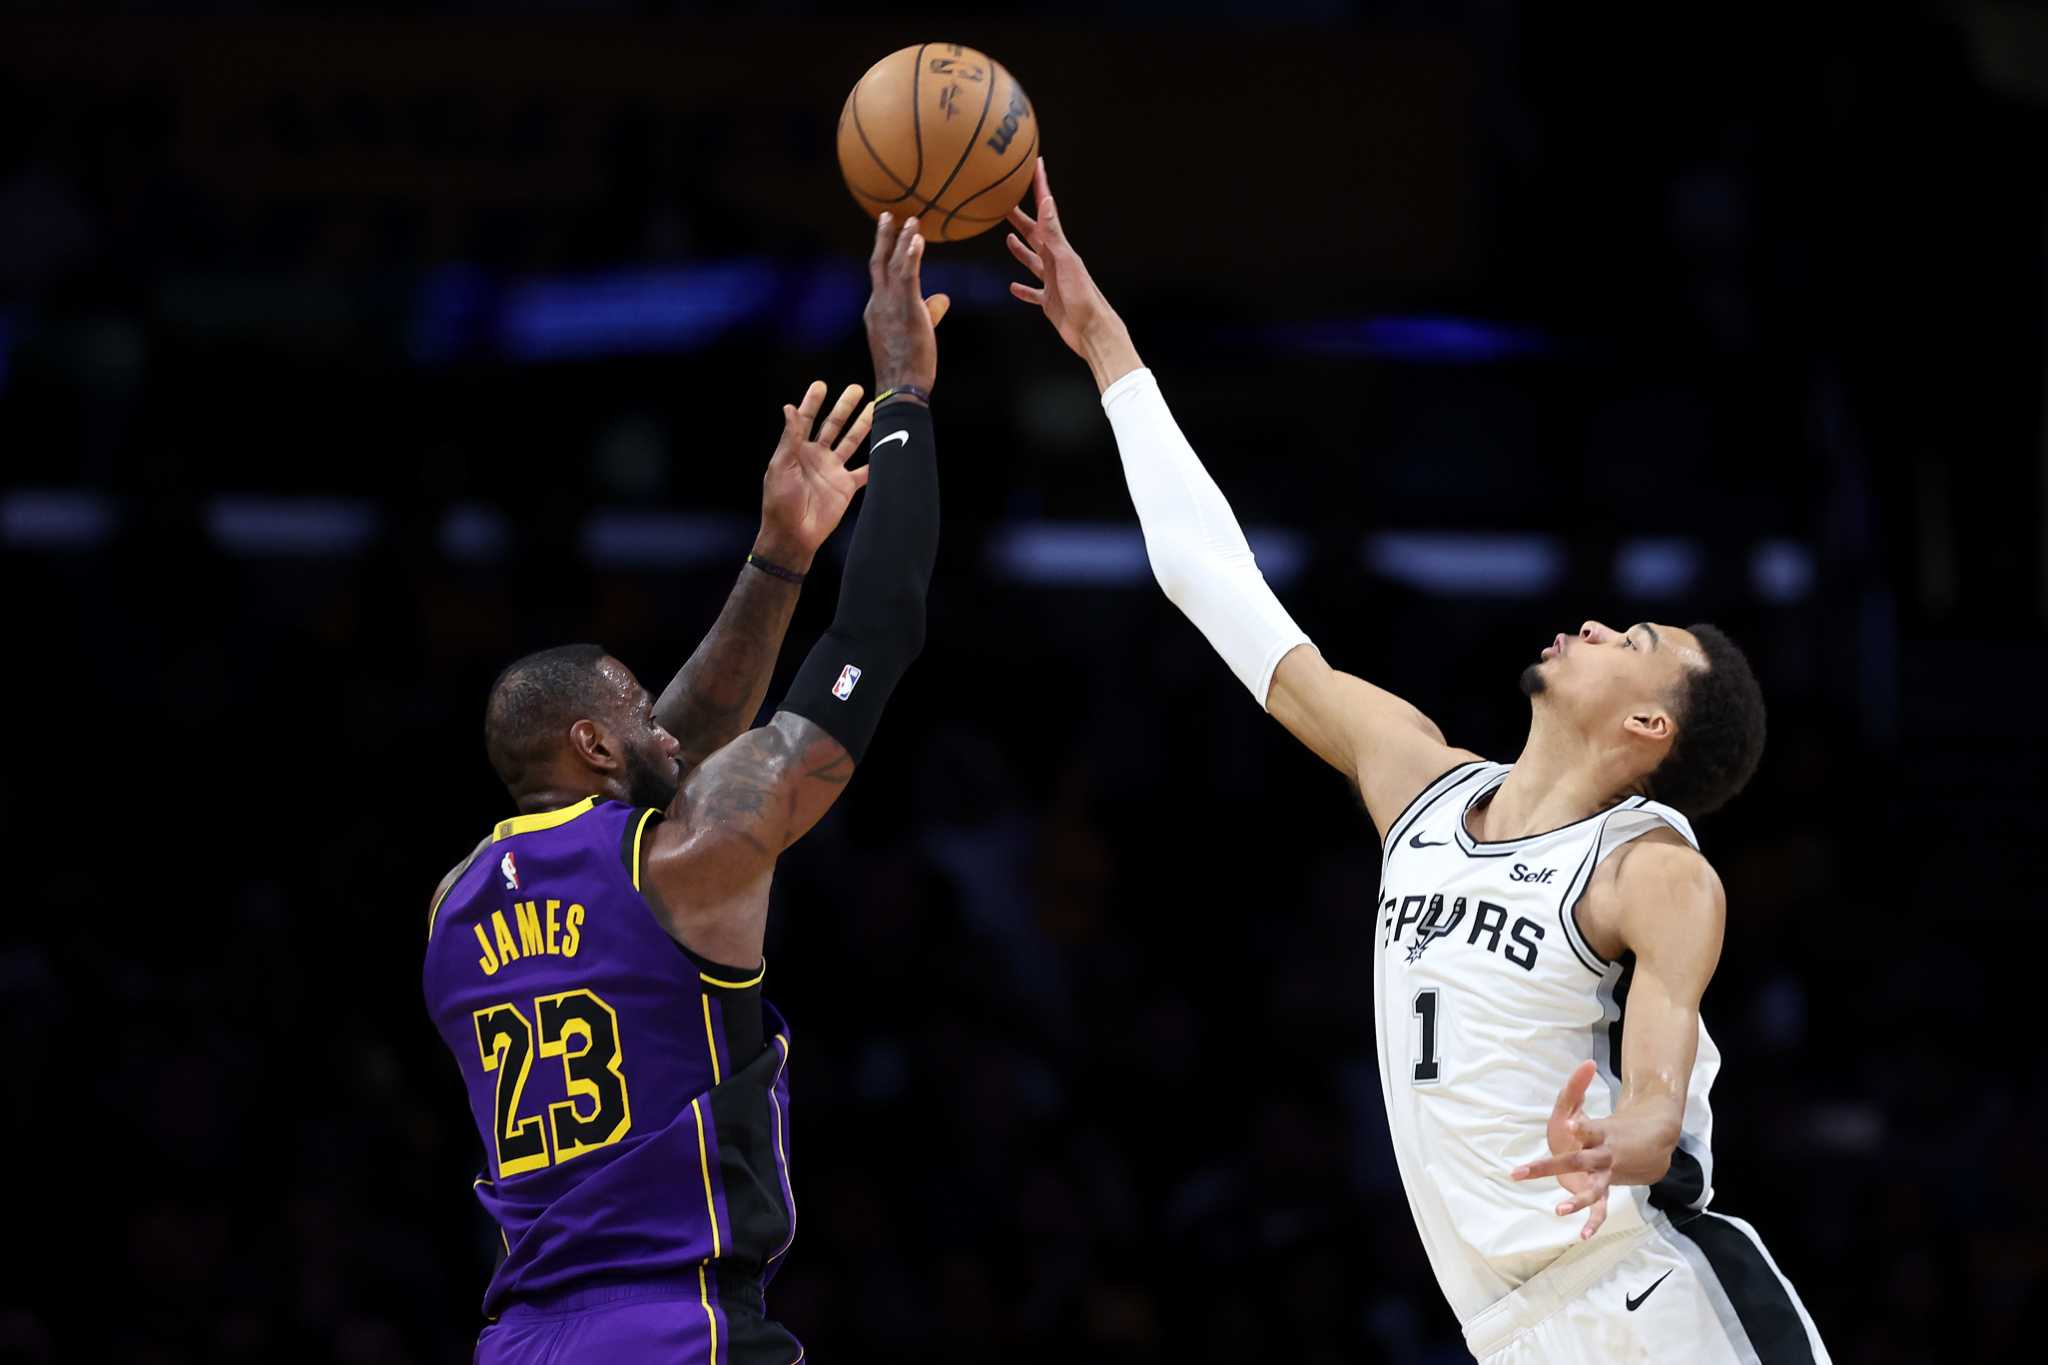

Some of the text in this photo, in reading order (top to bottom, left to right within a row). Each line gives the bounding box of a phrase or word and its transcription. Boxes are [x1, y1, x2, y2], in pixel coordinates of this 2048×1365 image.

[473, 899, 586, 977] JAMES
[472, 988, 632, 1180] 23
[1411, 987, 1441, 1085] 1
